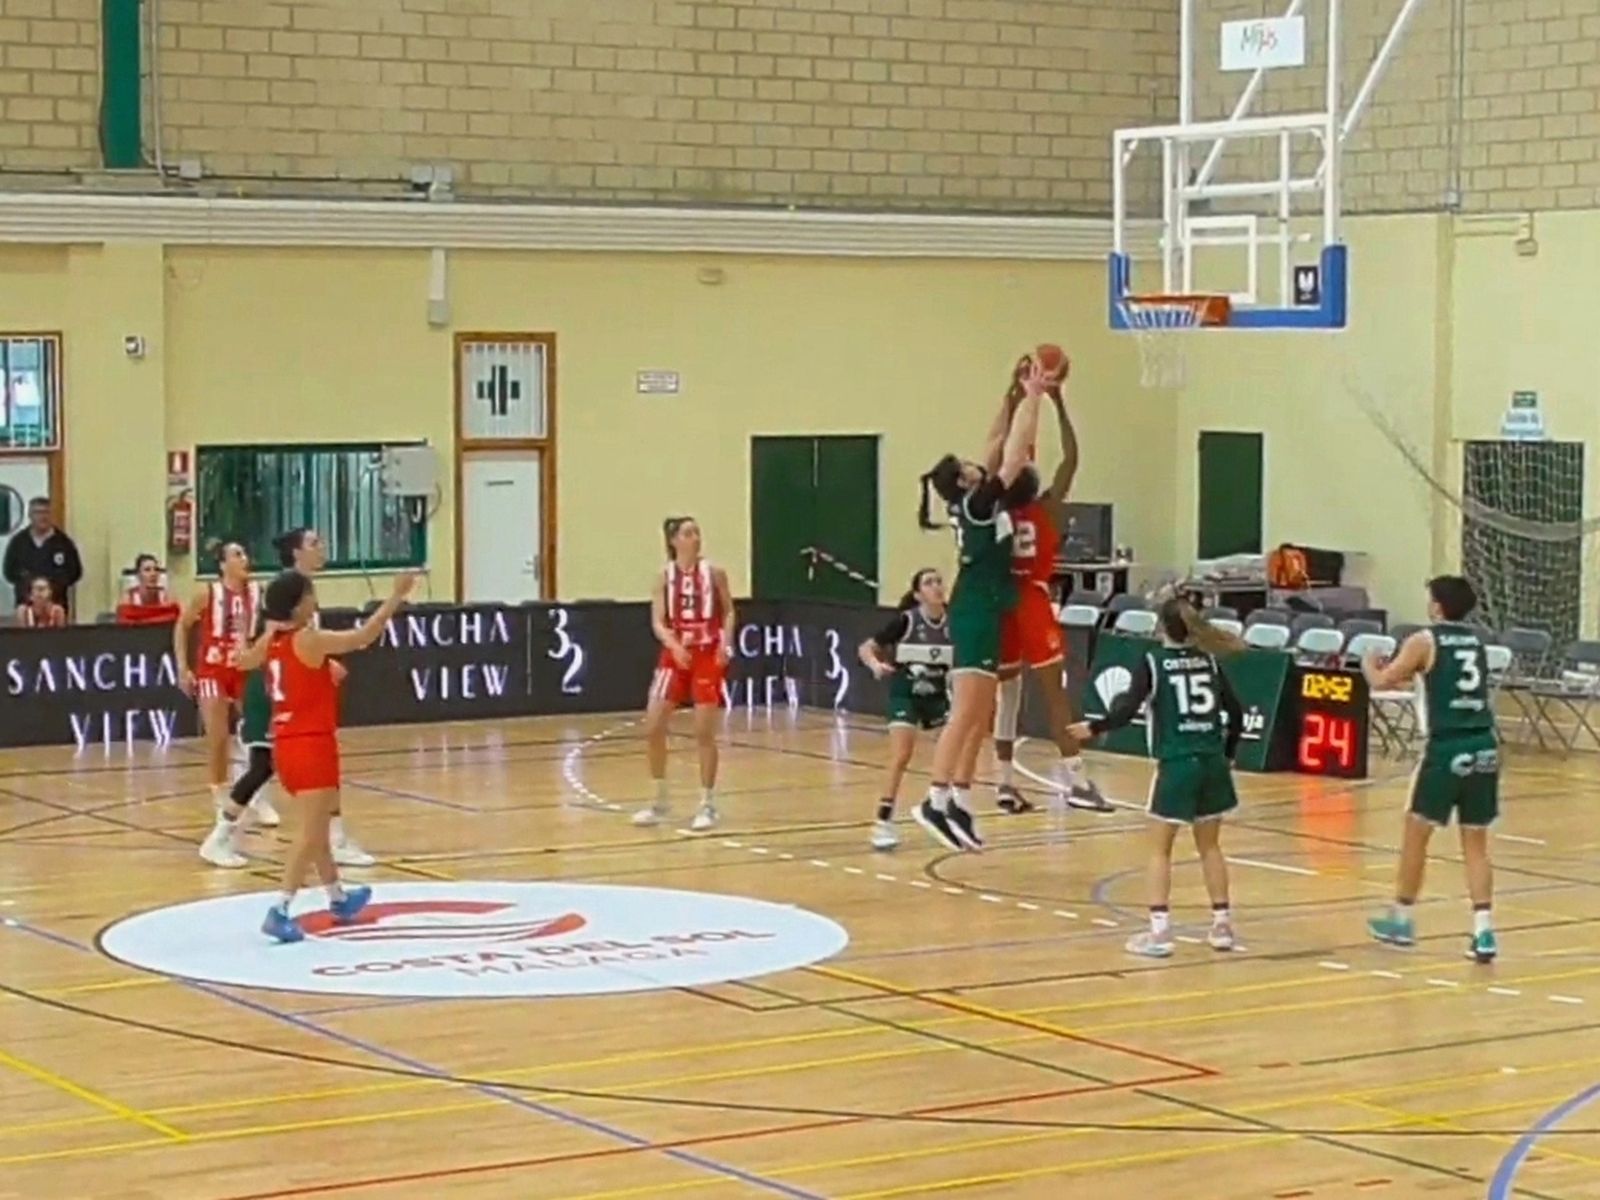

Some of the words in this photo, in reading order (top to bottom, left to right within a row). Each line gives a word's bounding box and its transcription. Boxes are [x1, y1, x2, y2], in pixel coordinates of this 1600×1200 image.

[6, 652, 177, 695] SANCHA
[268, 658, 285, 701] 1
[411, 664, 508, 701] VIEW
[1453, 650, 1480, 691] 3
[1169, 674, 1215, 714] 15
[1300, 714, 1350, 766] 24
[312, 951, 523, 976] COSTA
[525, 940, 652, 957] DEL
[651, 929, 776, 944] SOL
